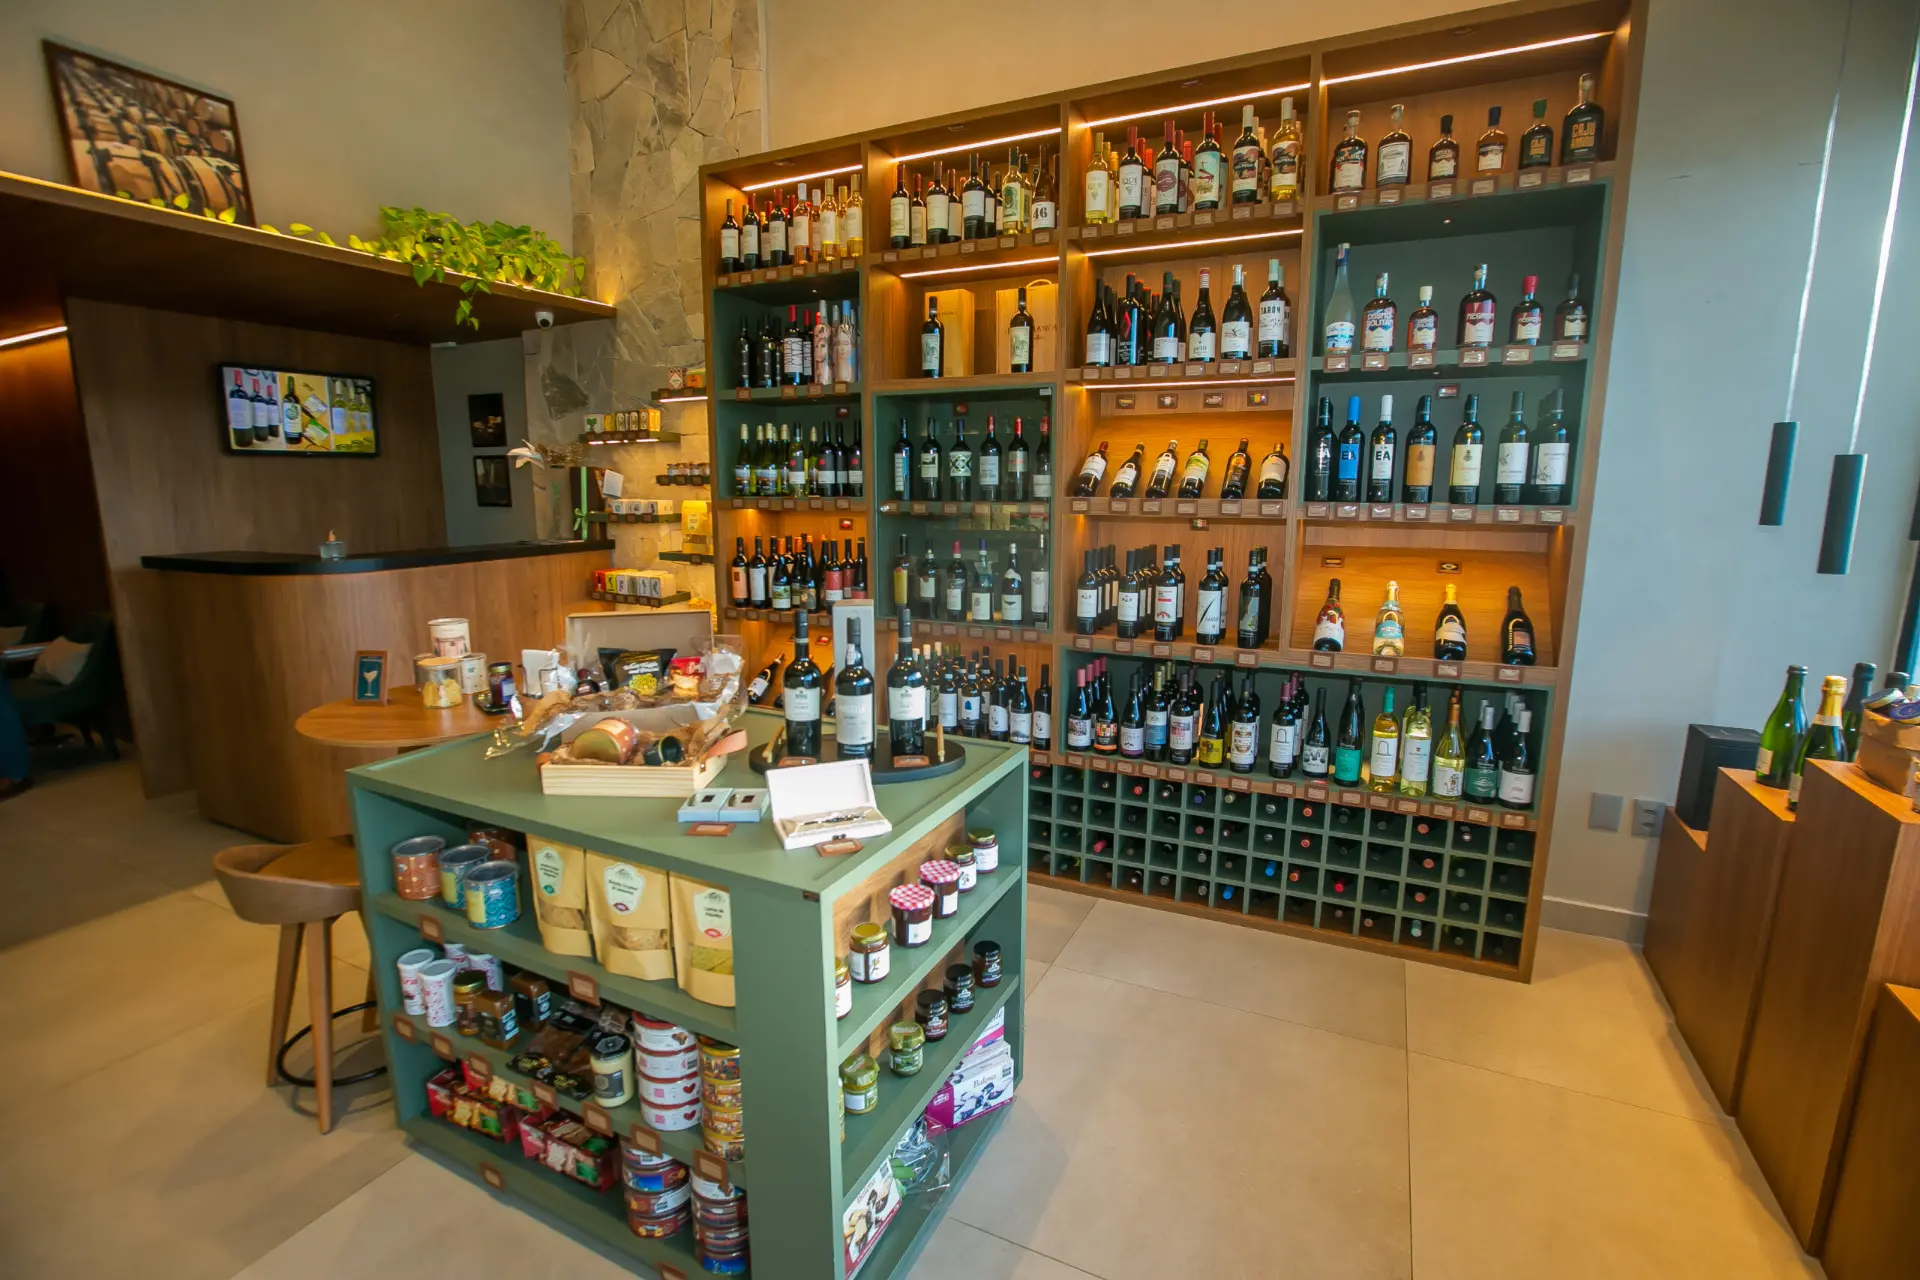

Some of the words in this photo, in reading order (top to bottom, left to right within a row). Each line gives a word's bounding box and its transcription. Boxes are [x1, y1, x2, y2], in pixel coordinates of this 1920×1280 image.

[1033, 206, 1048, 220] 46
[1341, 450, 1357, 460] EA
[1375, 450, 1391, 461] EA
